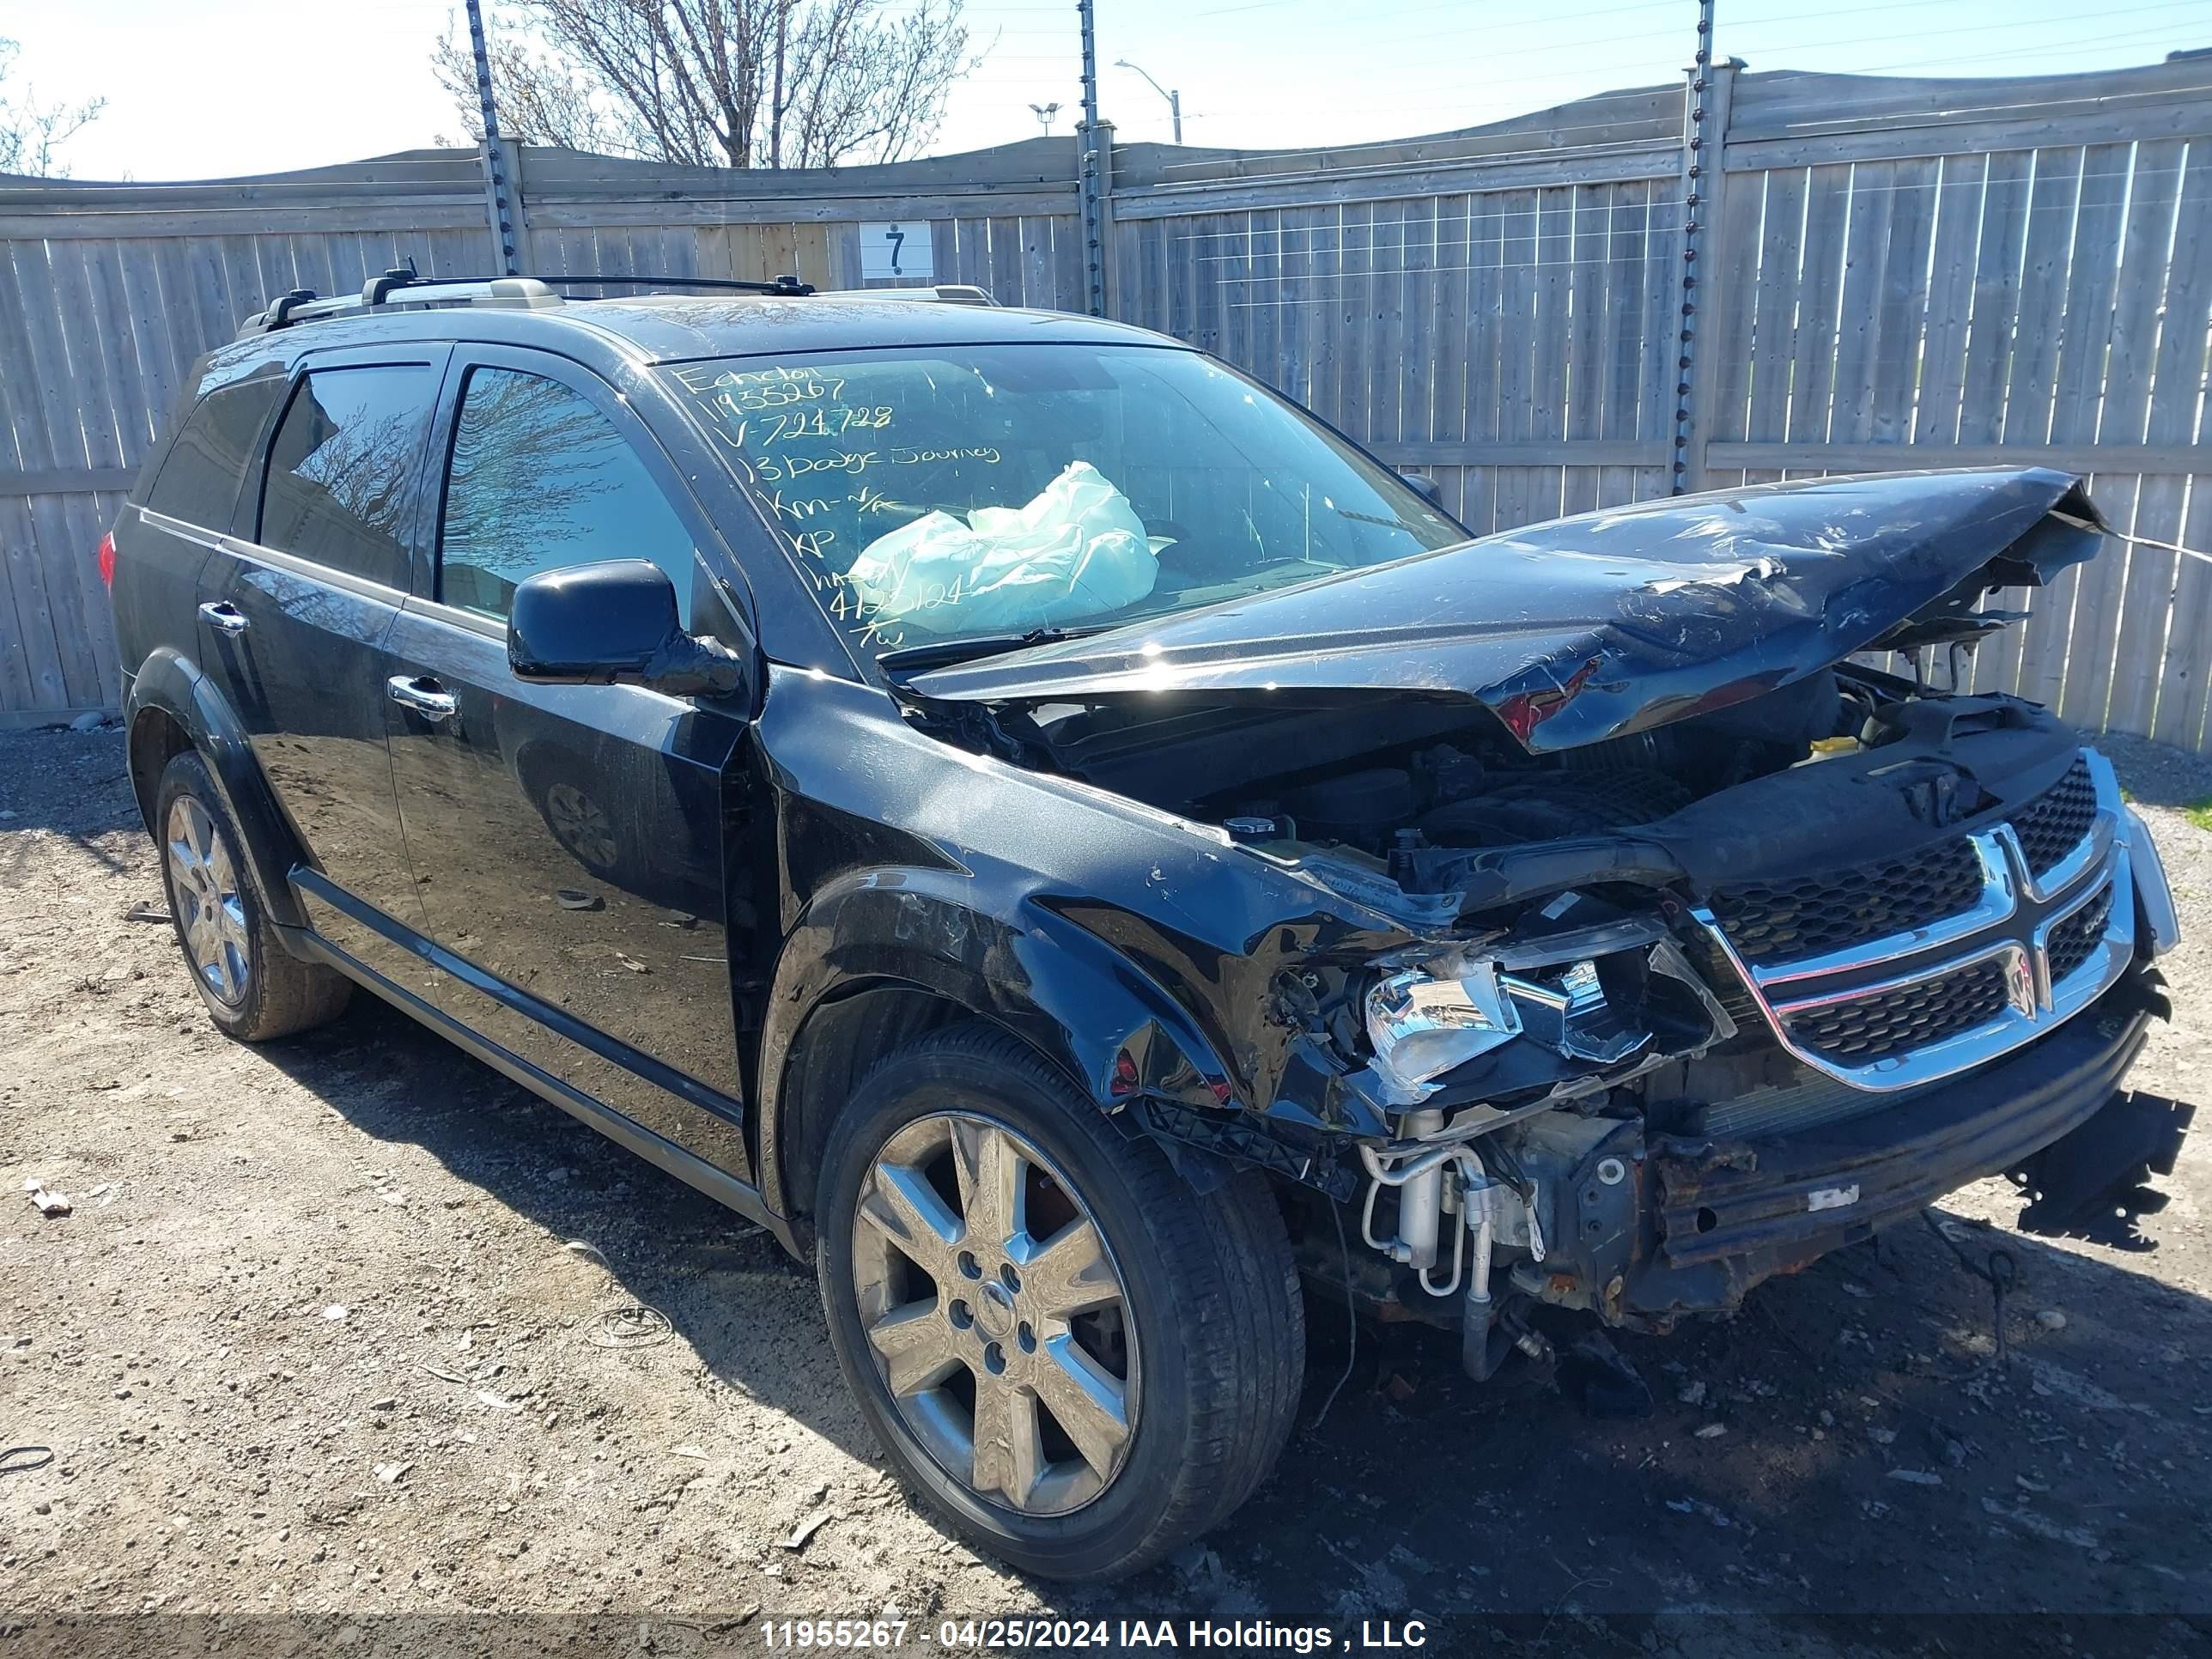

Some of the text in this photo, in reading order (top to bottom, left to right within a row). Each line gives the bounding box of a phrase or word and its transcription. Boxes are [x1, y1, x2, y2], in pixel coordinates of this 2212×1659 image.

[885, 232, 905, 268] 7
[696, 379, 846, 423] 11955267
[889, 446, 1001, 464] Journey
